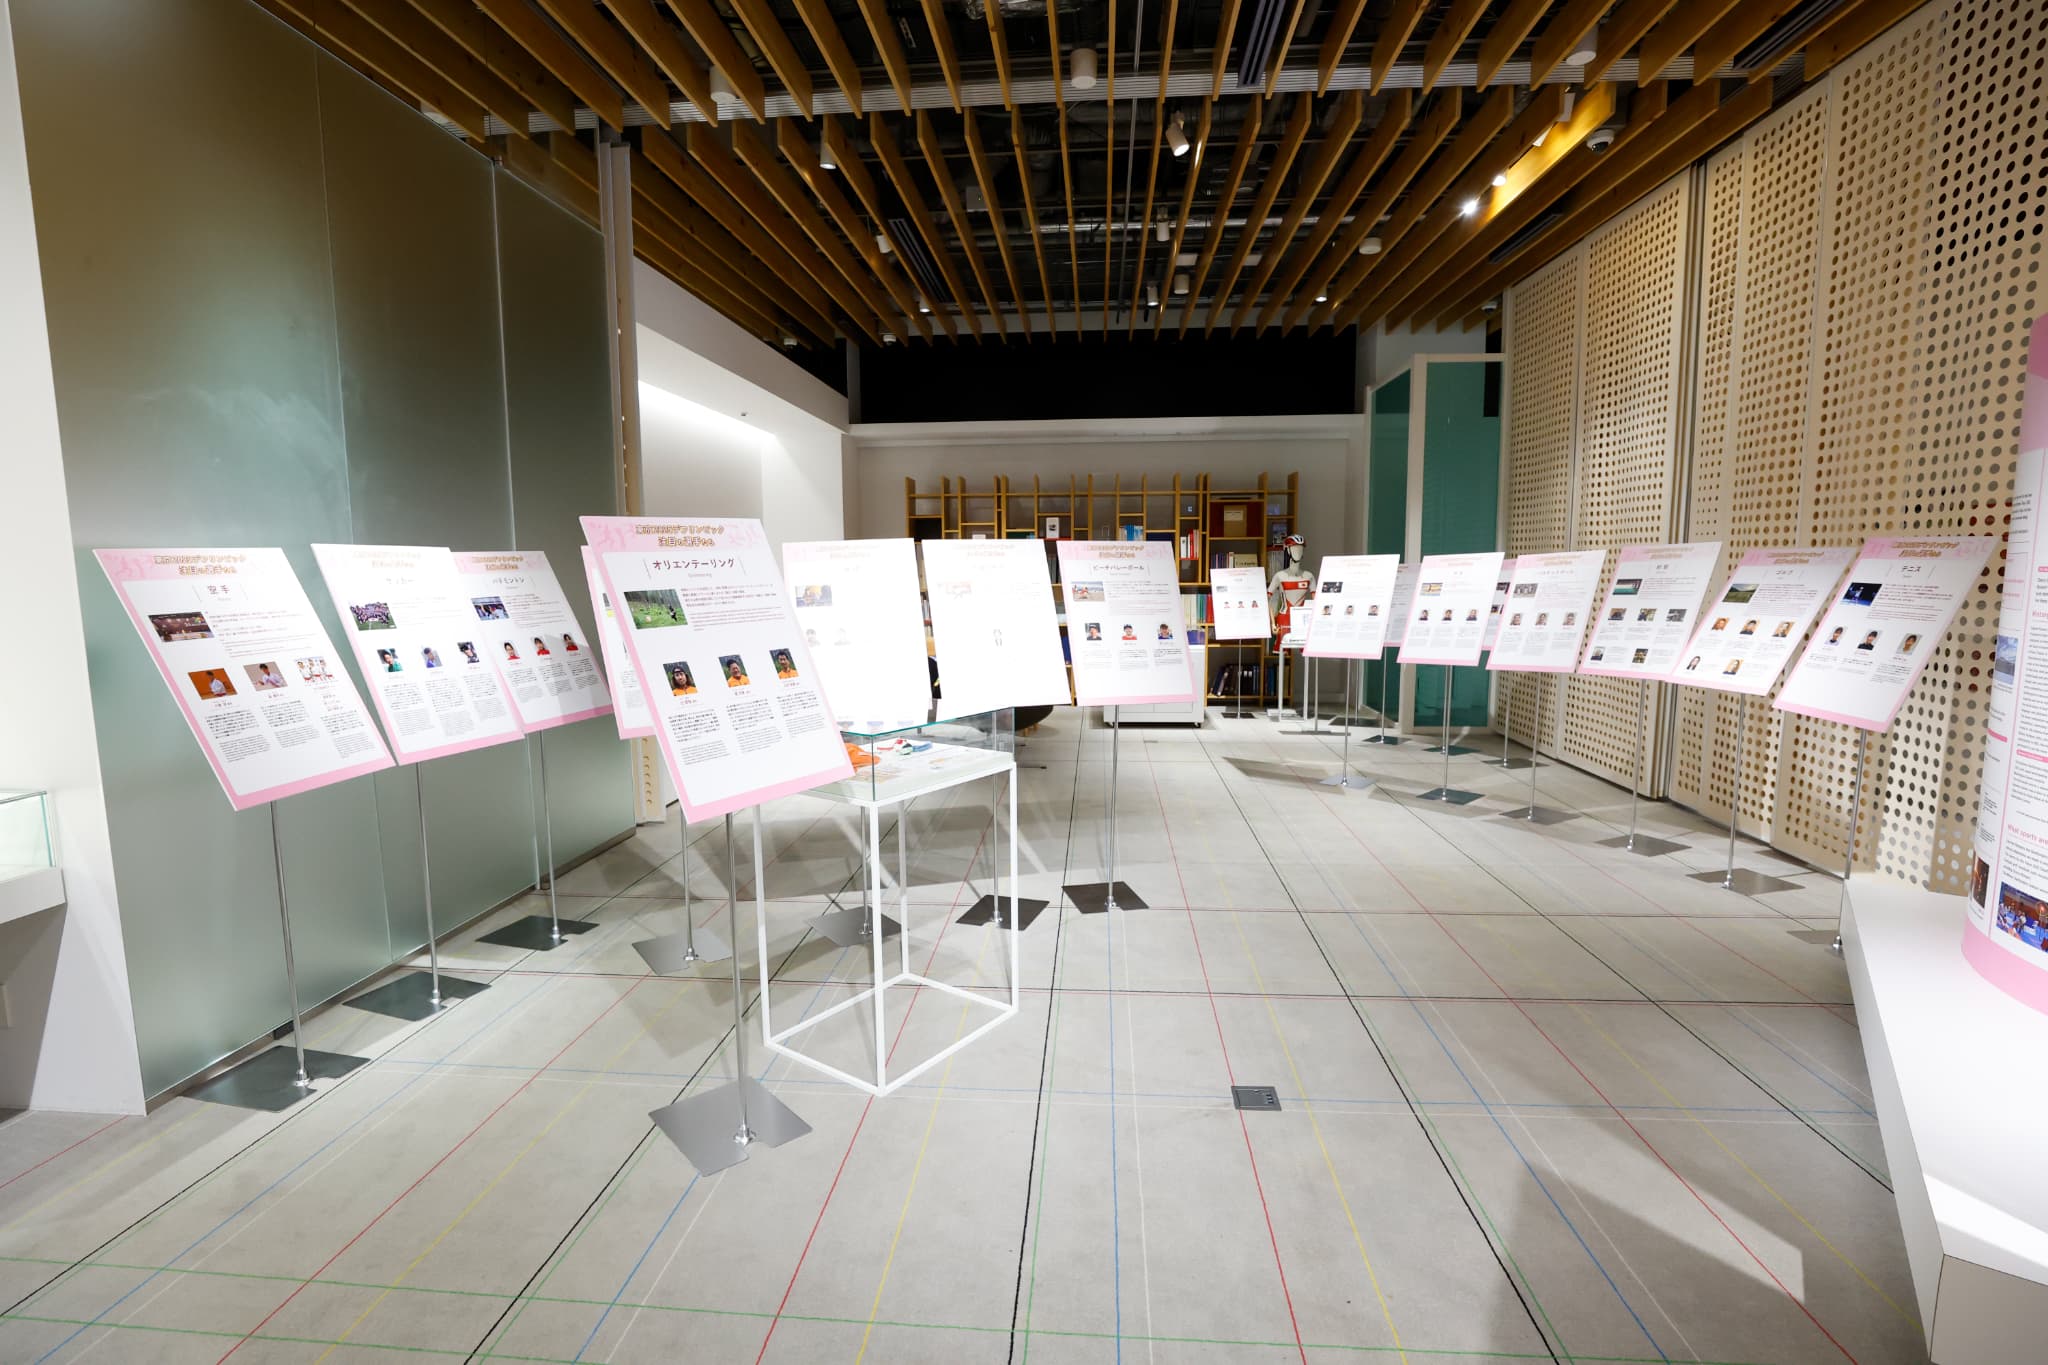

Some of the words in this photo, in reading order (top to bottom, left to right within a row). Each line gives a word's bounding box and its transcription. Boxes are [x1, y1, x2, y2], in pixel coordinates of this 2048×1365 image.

[652, 558, 735, 570] オリエンテーリング
